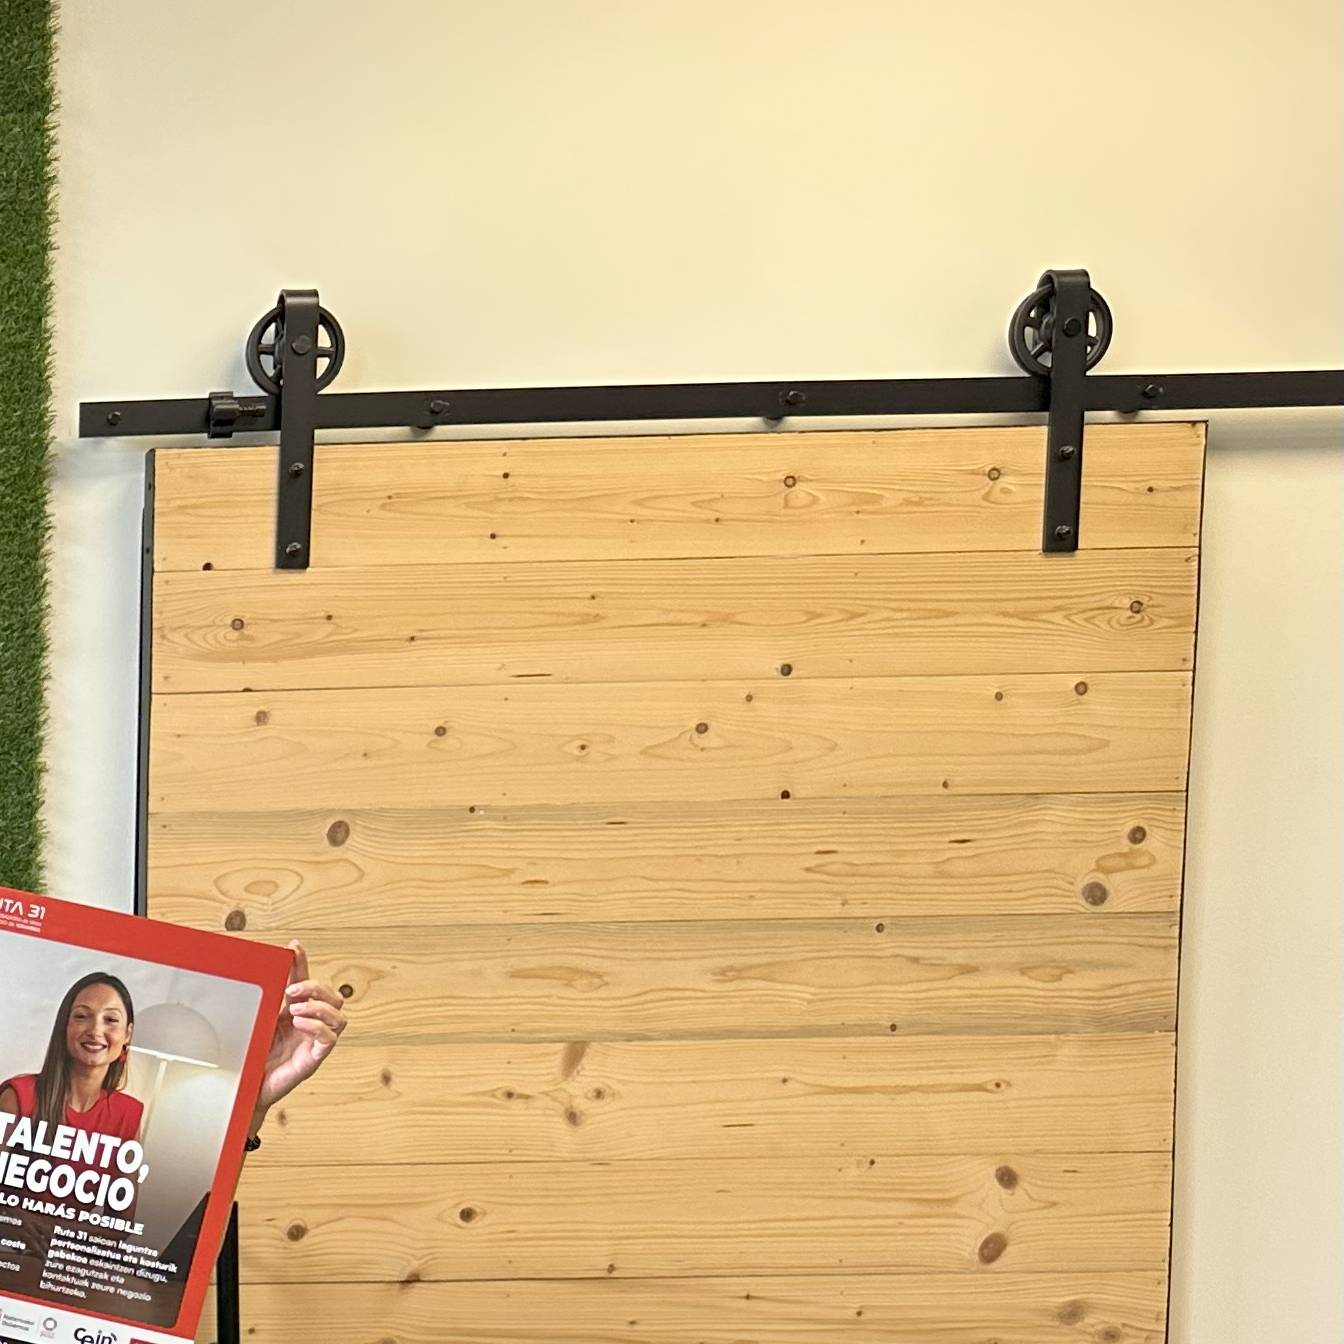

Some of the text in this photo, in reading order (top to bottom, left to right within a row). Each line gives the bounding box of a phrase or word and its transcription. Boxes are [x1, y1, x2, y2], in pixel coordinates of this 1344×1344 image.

[27, 904, 46, 919] 31
[21, 1197, 76, 1220] HARÁS
[77, 1210, 145, 1236] POSIBLE
